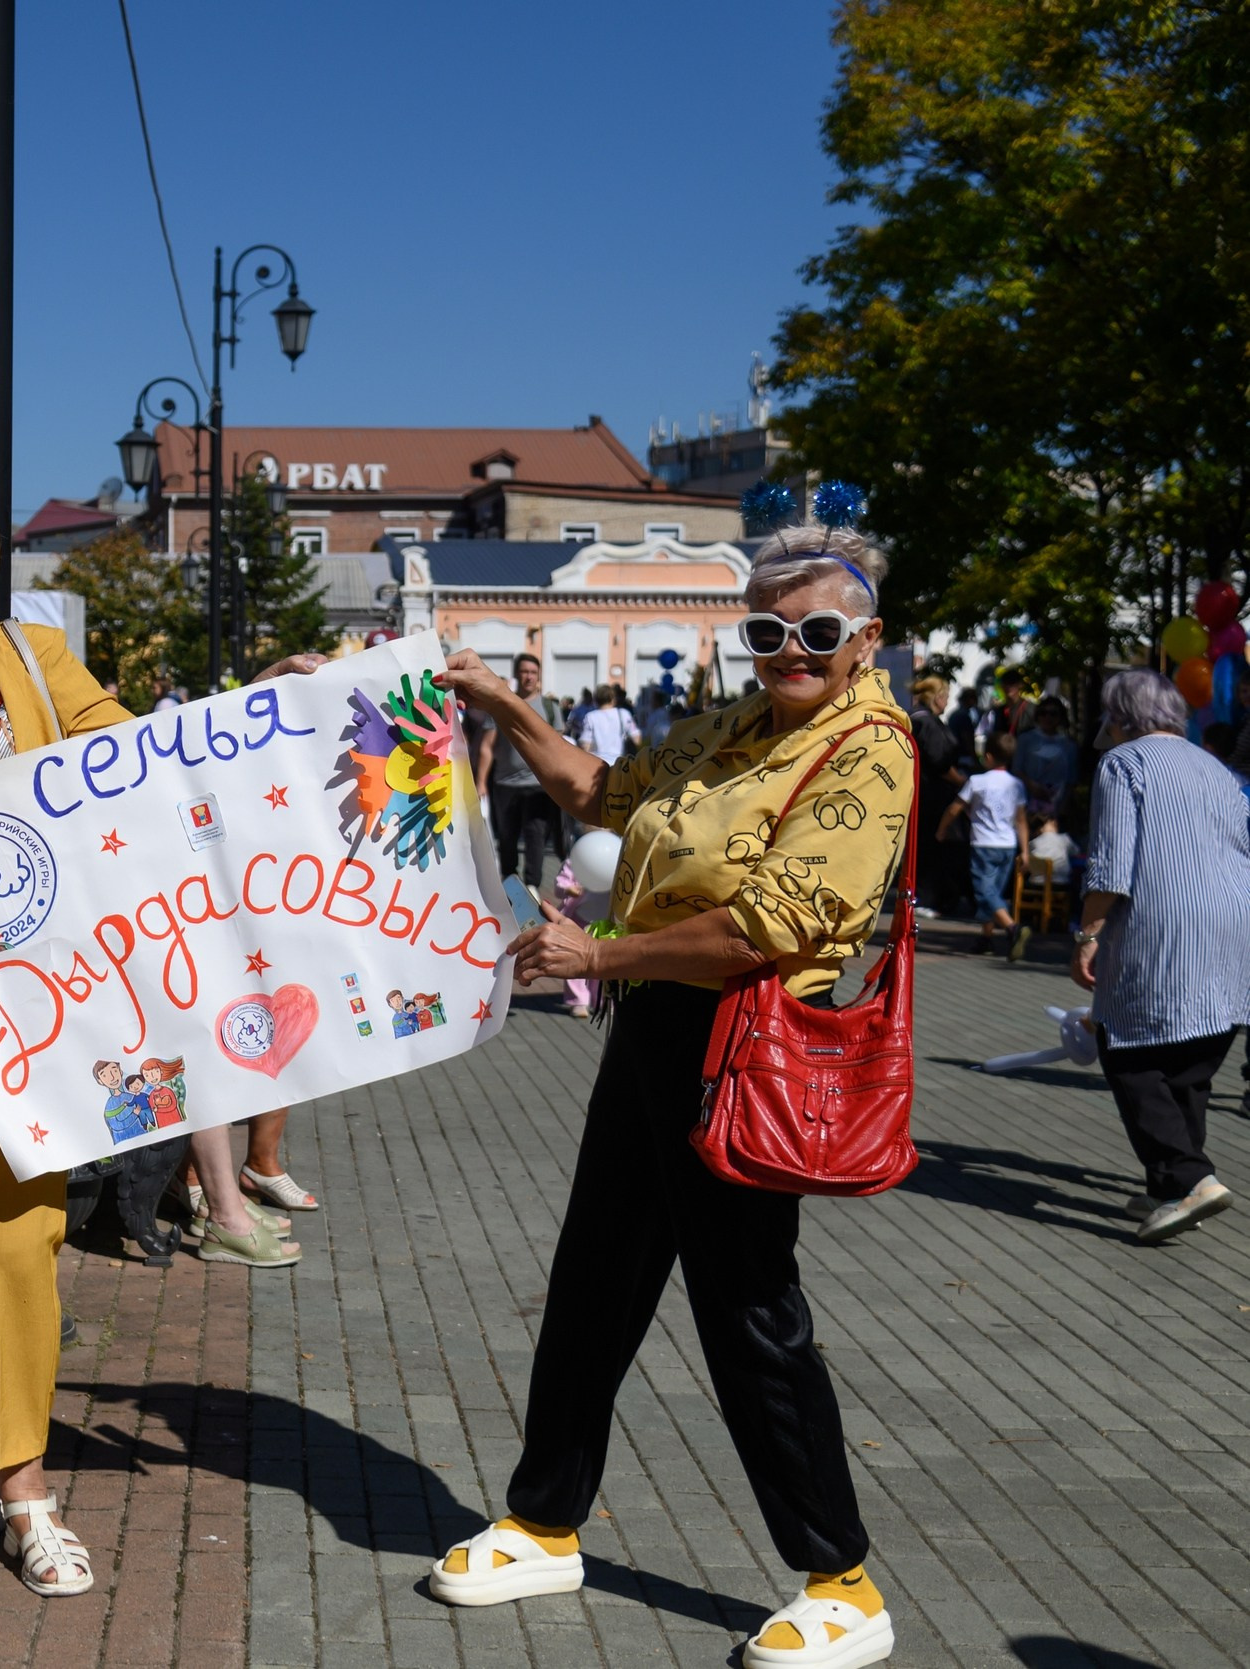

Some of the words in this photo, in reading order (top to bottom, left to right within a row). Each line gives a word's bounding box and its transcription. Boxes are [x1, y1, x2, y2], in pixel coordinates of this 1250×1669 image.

[38, 856, 50, 888] ИГРЫ
[798, 856, 827, 865] MEAN
[0, 914, 37, 943] 2024
